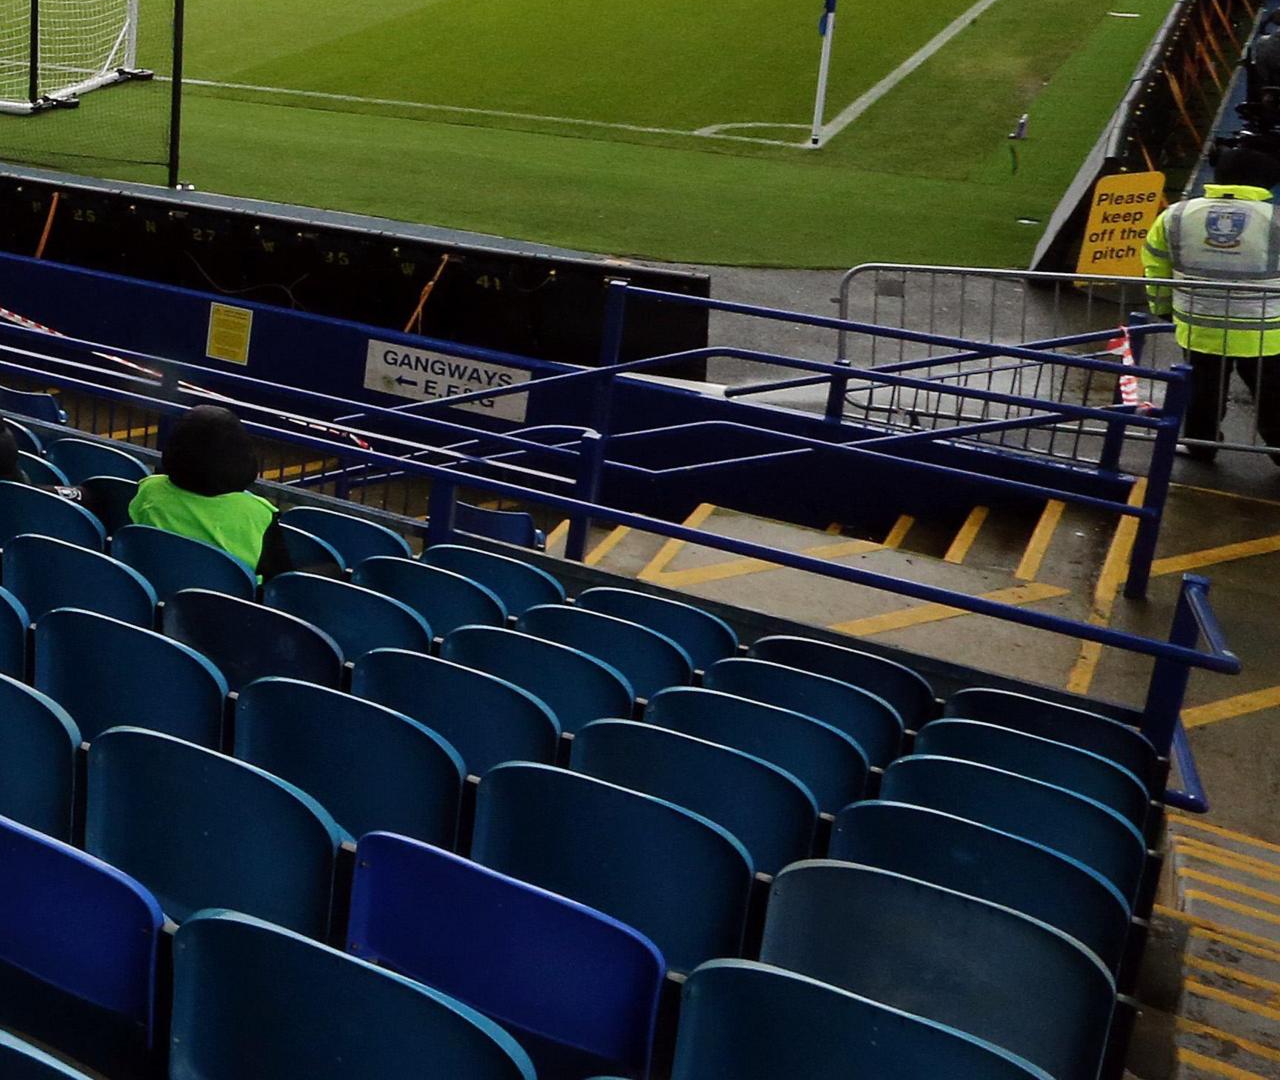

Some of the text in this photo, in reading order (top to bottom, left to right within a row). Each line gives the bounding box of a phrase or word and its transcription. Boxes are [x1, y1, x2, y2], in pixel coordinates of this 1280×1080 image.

[1096, 190, 1157, 207] Please
[1101, 210, 1144, 226] keep
[1088, 227, 1148, 243] off the
[1091, 246, 1137, 264] pitch
[383, 349, 513, 389] GANGWAYS
